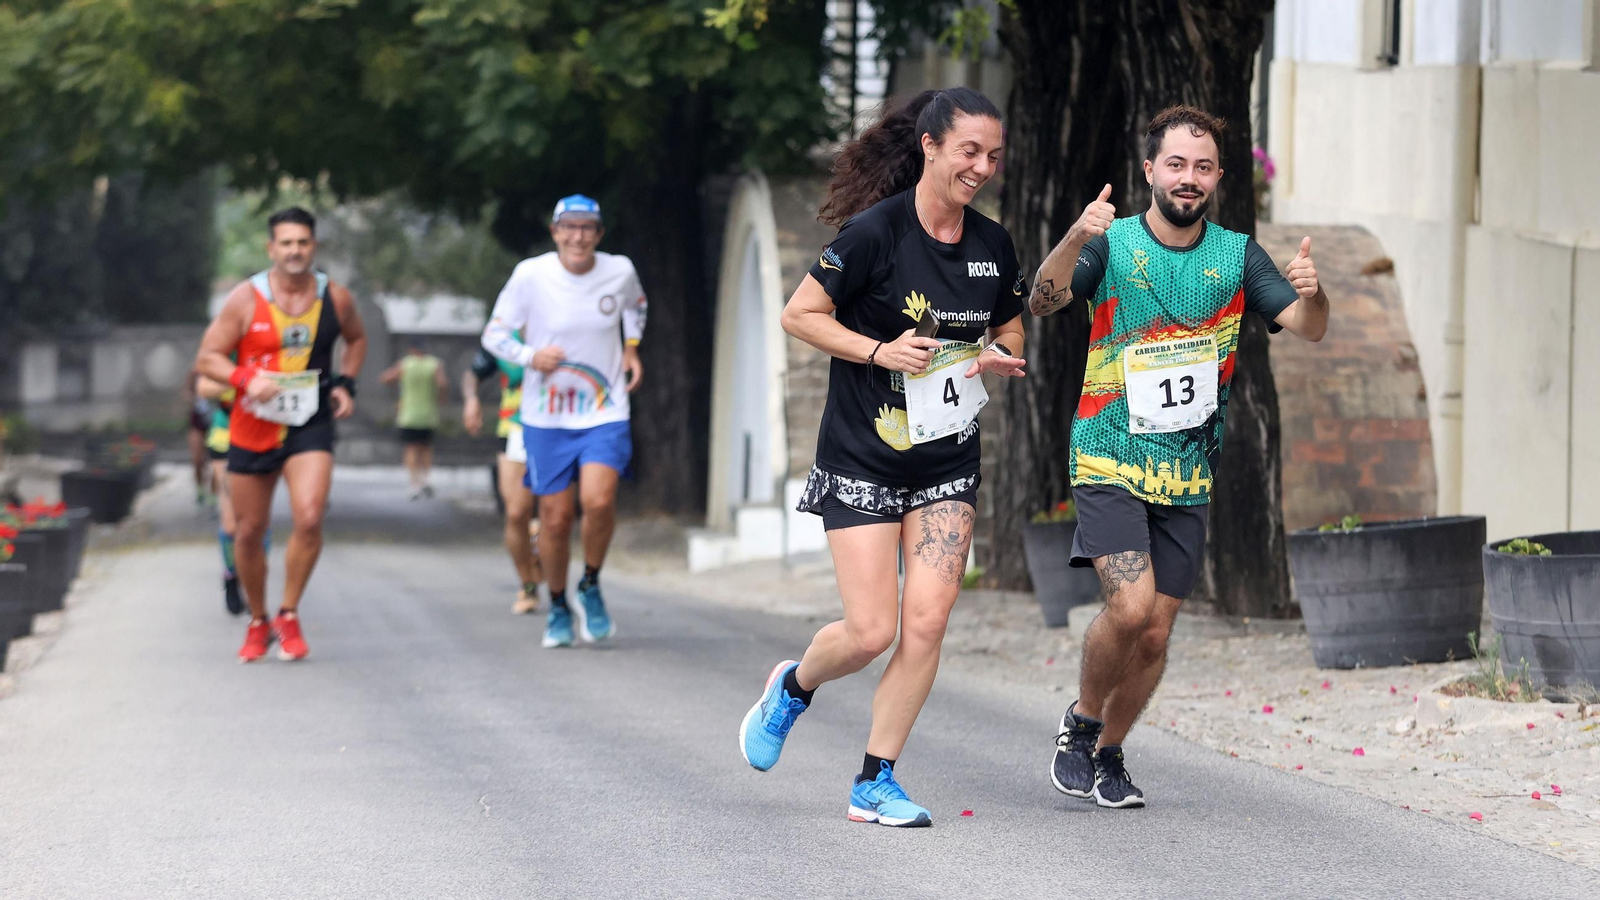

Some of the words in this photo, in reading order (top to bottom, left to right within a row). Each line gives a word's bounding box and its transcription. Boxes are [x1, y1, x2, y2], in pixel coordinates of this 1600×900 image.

[942, 342, 981, 352] SOLIDA
[1134, 345, 1171, 356] CARRERA
[1173, 338, 1212, 351] SOLIDARIA
[943, 377, 959, 407] 4
[1159, 375, 1195, 408] 13
